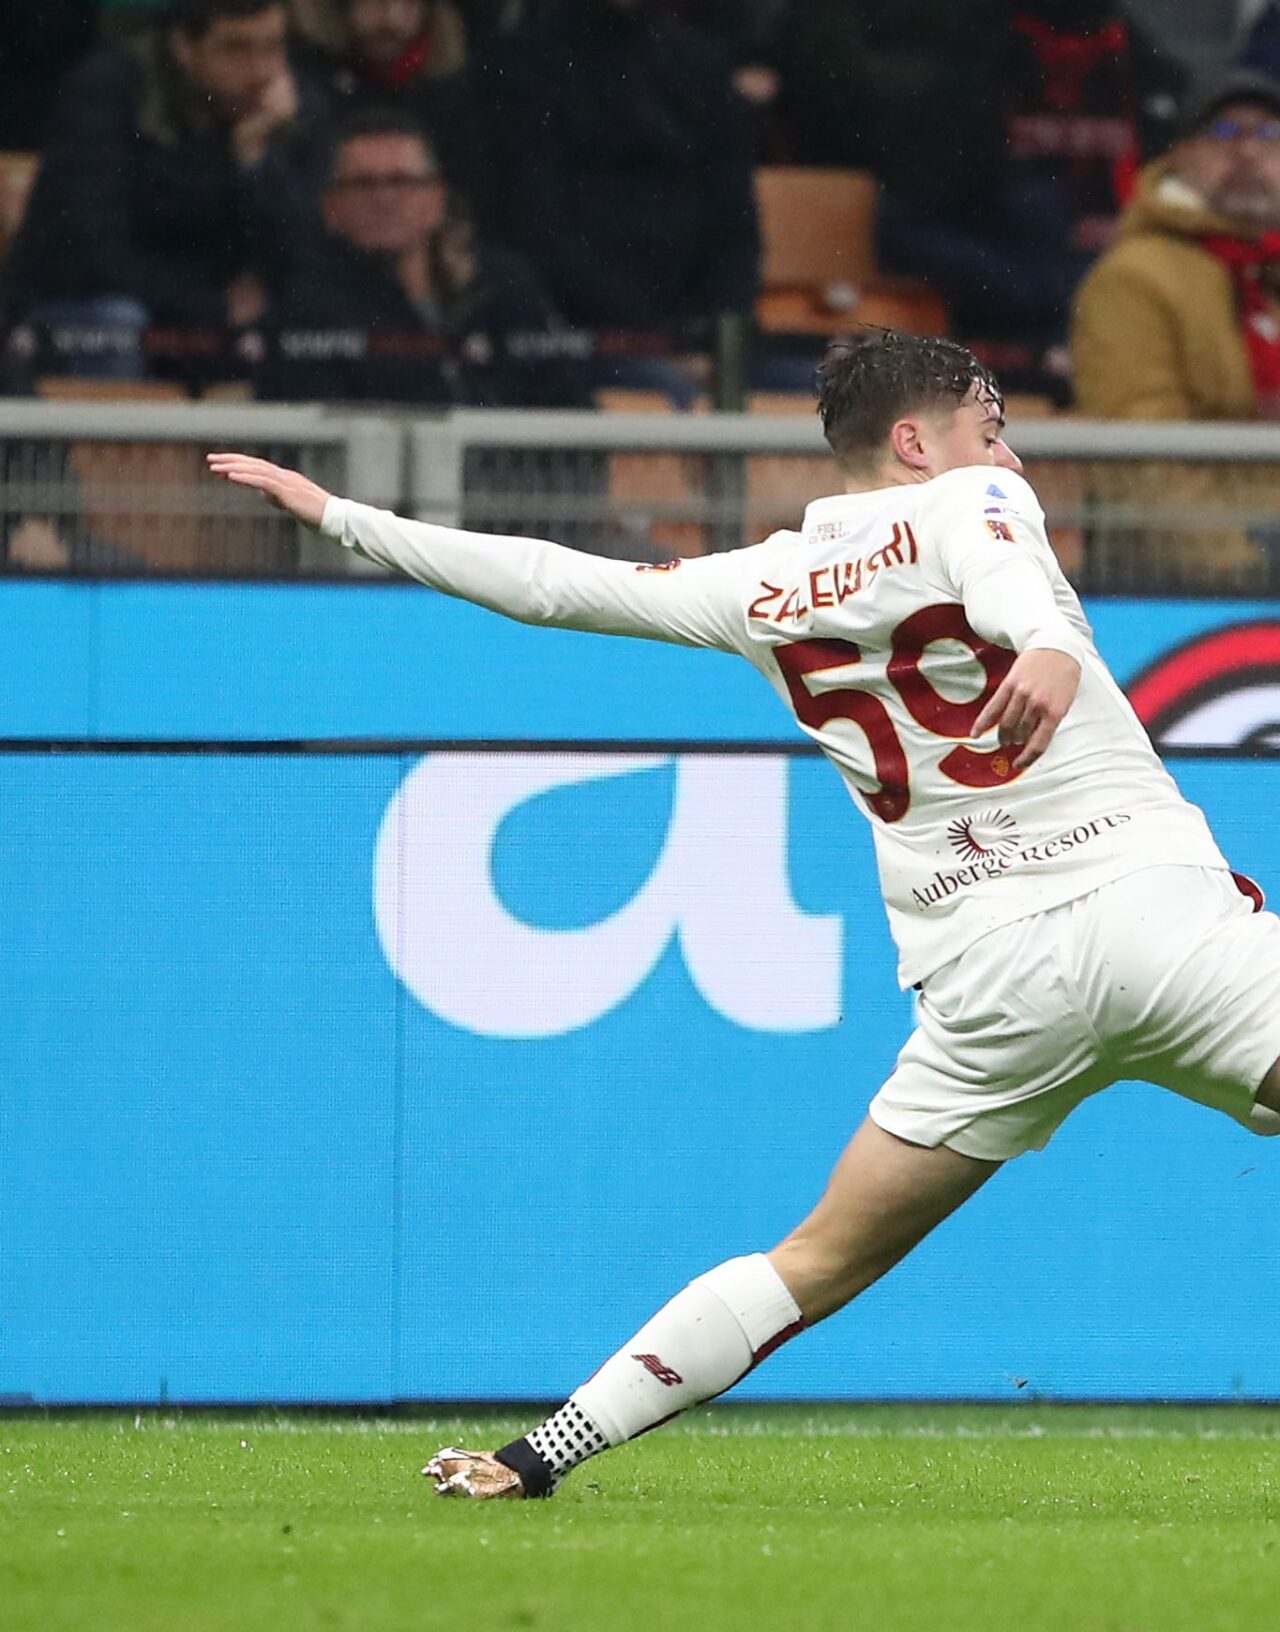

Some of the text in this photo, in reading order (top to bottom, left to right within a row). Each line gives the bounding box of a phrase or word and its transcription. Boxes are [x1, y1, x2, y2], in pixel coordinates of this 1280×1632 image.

[771, 603, 1028, 824] 59
[910, 811, 1131, 912] Auberge Resorts
